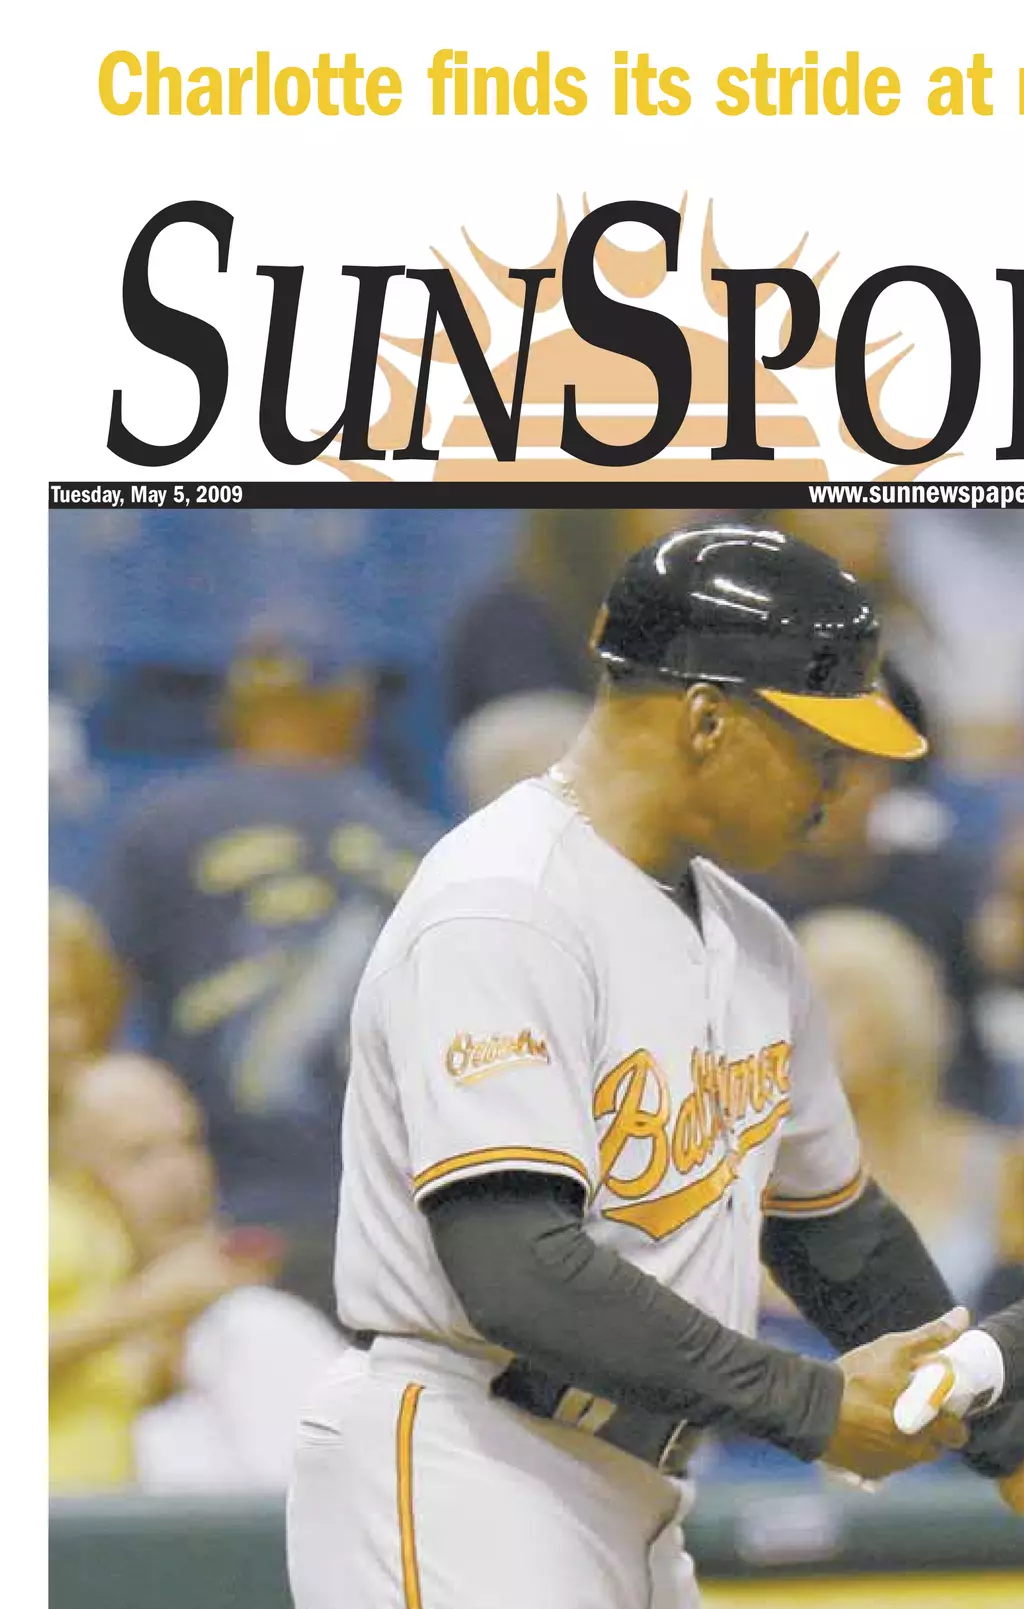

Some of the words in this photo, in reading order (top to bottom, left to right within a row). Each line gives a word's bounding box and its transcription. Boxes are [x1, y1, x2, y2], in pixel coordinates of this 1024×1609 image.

[97, 49, 403, 117] Charlotte
[427, 48, 588, 117] finds
[614, 50, 692, 117] its
[715, 50, 901, 117] stride
[927, 53, 994, 117] at
[50, 485, 125, 507] Tuesday,
[131, 485, 167, 507] May
[173, 485, 190, 507] 5,
[196, 485, 243, 503] 2009
